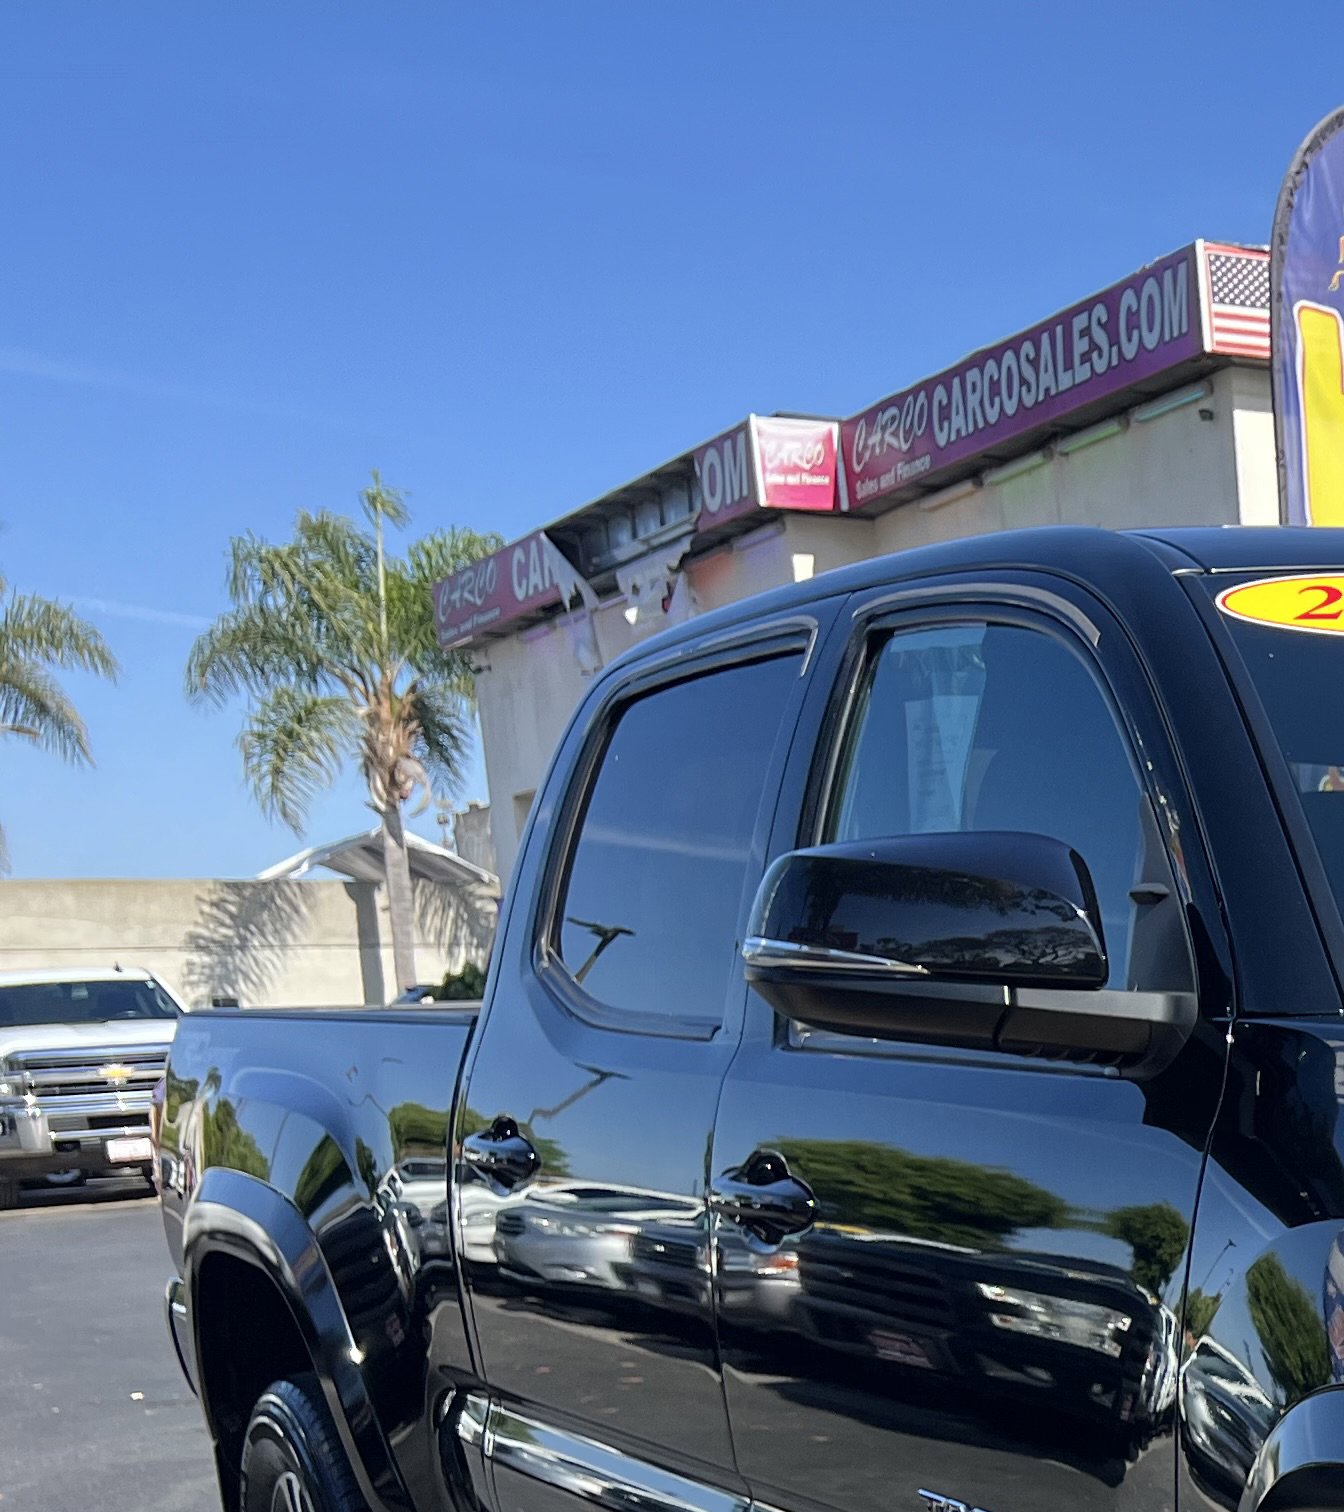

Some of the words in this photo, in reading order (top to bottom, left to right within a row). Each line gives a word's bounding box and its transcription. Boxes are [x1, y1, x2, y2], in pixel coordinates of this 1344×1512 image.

[853, 389, 928, 474] CARCO
[932, 259, 1190, 449] CARCOSALES.COM
[694, 431, 749, 513] OM
